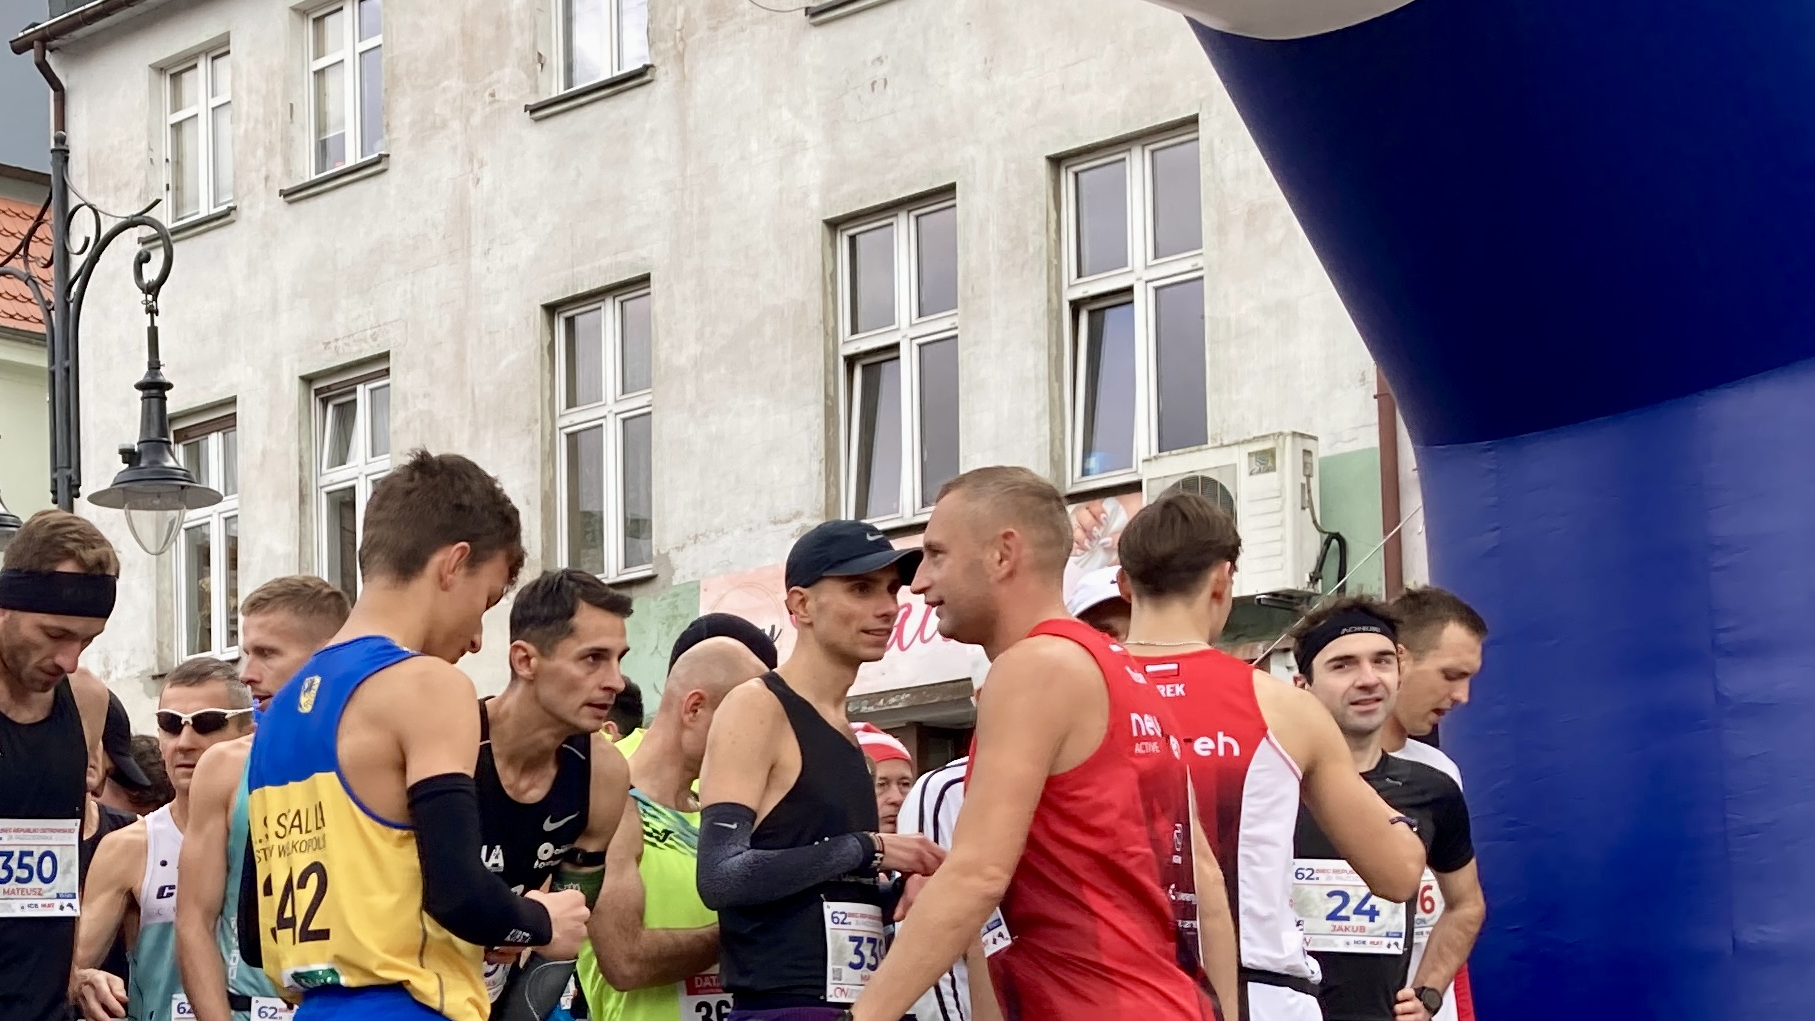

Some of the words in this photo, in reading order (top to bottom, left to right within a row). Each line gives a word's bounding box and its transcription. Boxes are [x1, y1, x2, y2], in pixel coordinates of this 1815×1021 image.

[1294, 867, 1320, 881] 62.
[2, 887, 44, 897] MATEUSZ
[1325, 889, 1380, 923] 24
[1331, 924, 1366, 933] JAKUB
